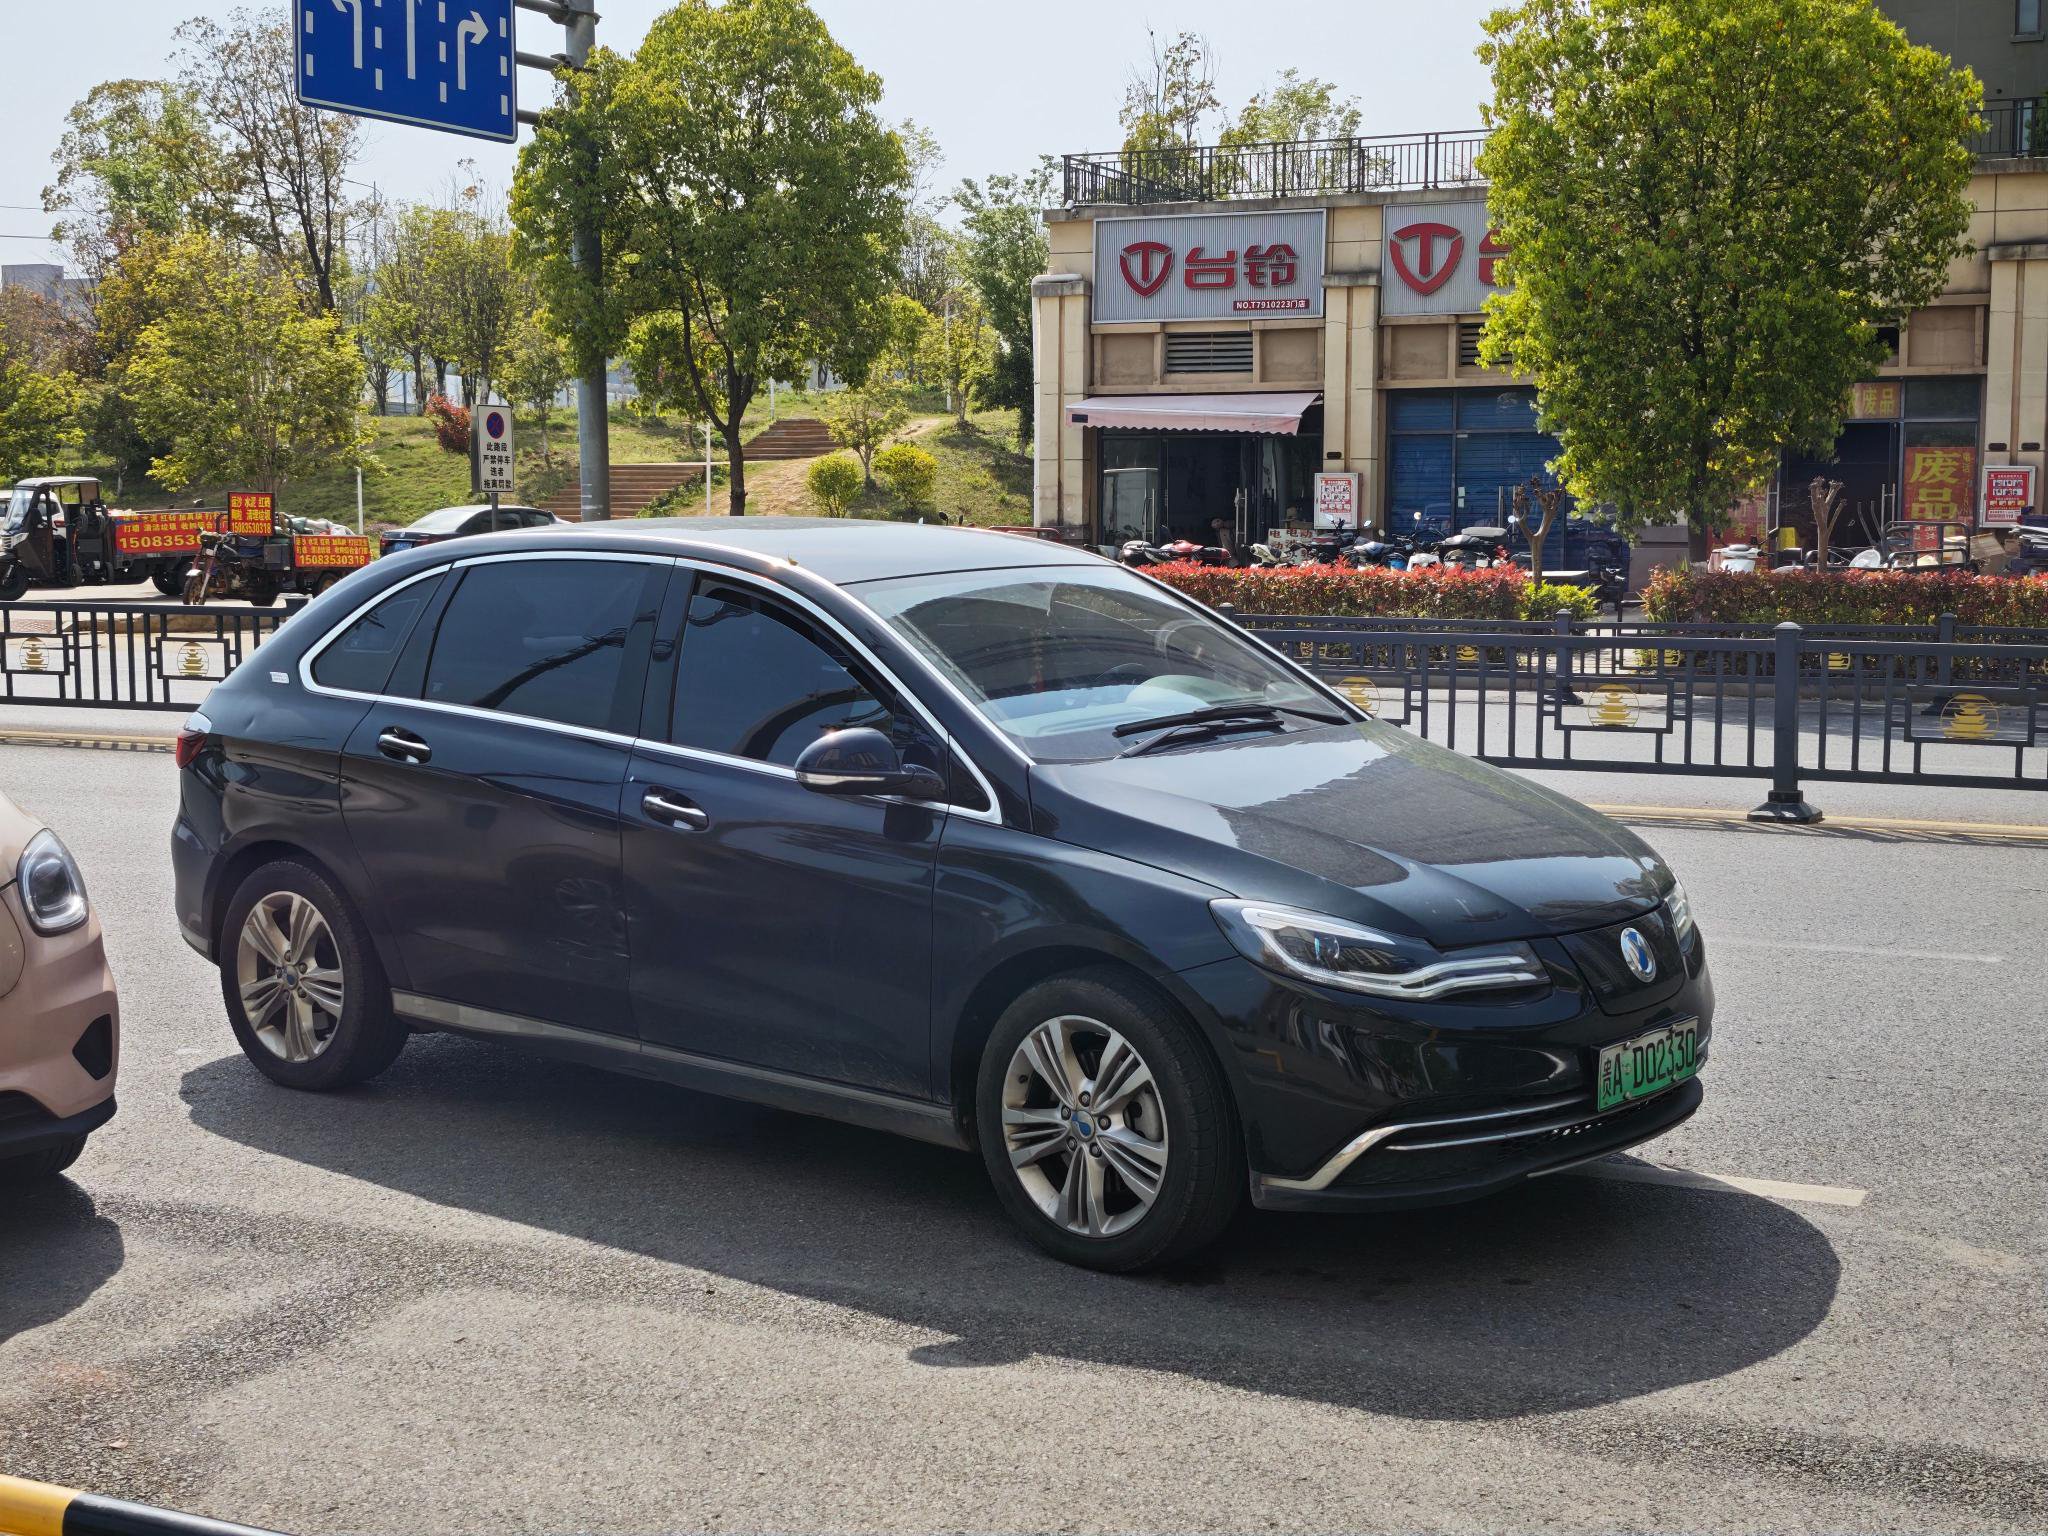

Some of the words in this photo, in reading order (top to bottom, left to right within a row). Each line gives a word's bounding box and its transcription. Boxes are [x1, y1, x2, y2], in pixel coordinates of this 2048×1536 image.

[1184, 244, 1298, 289] 台铃
[486, 442, 508, 452] 此路段
[483, 454, 511, 465] 严禁停车
[490, 467, 504, 477] 违者
[483, 479, 512, 490] 拖离罚款
[299, 555, 366, 565] 15083530318
